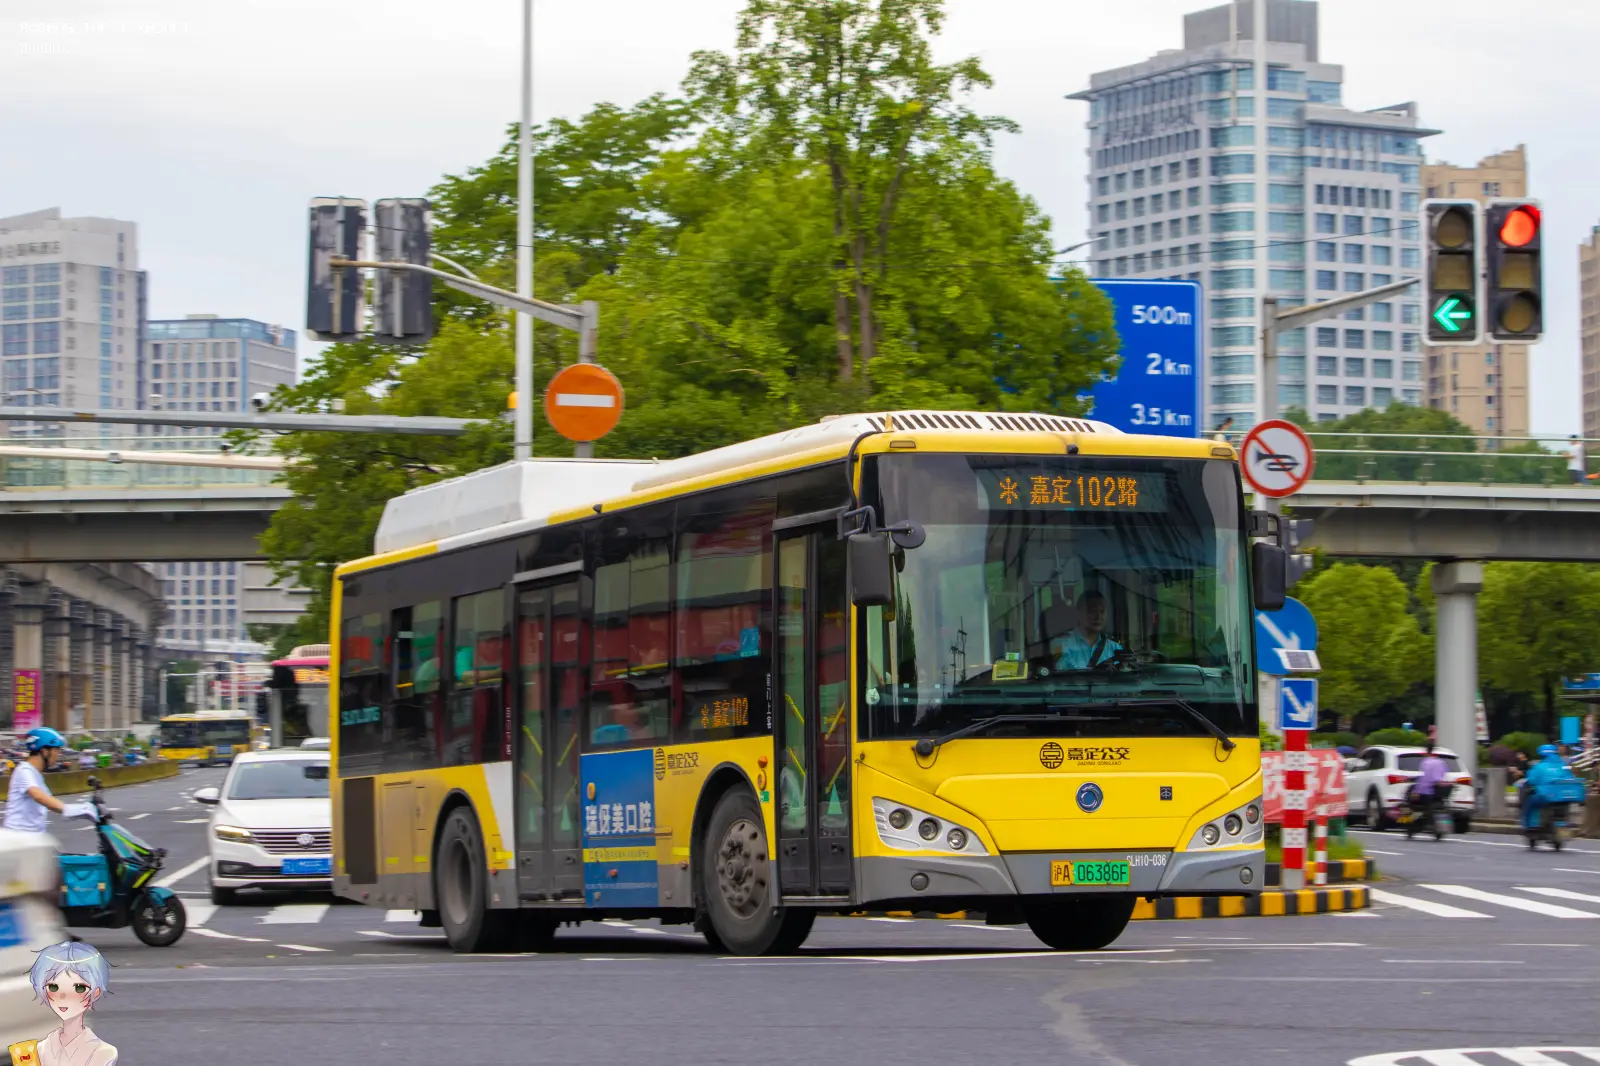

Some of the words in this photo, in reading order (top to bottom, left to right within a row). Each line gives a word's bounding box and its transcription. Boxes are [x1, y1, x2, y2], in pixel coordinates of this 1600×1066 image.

[1132, 305, 1192, 325] 500m
[1029, 475, 1139, 506] 嘉定102路
[1067, 747, 1131, 761] 嘉定公交
[1126, 854, 1167, 867] SLH10-036
